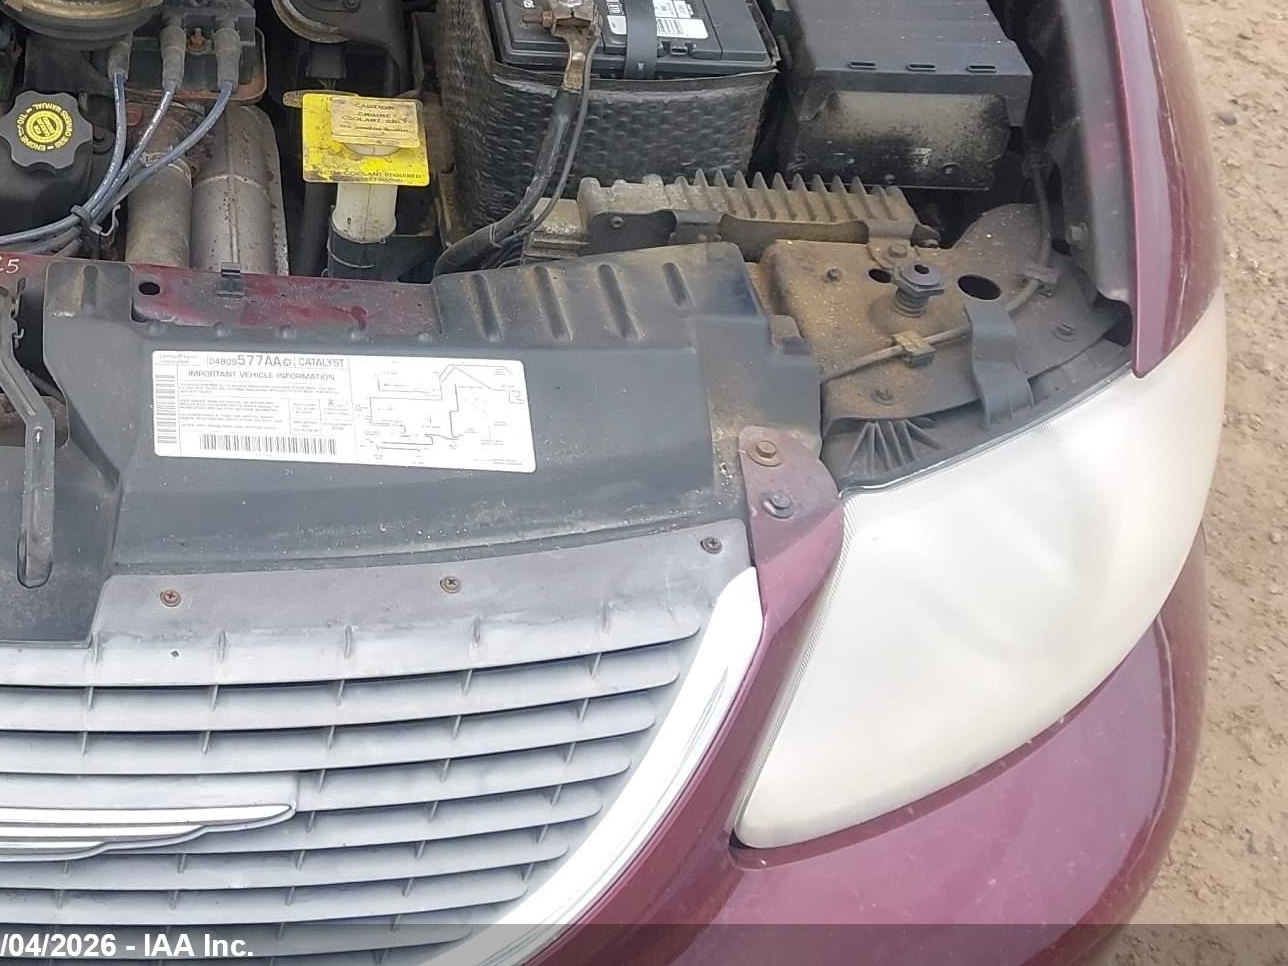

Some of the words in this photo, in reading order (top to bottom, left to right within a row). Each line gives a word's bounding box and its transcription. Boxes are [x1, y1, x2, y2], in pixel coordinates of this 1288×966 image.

[299, 358, 345, 368] CATALYST
[188, 370, 237, 379] IMPORTANT
[277, 373, 335, 381] INFORMATION
